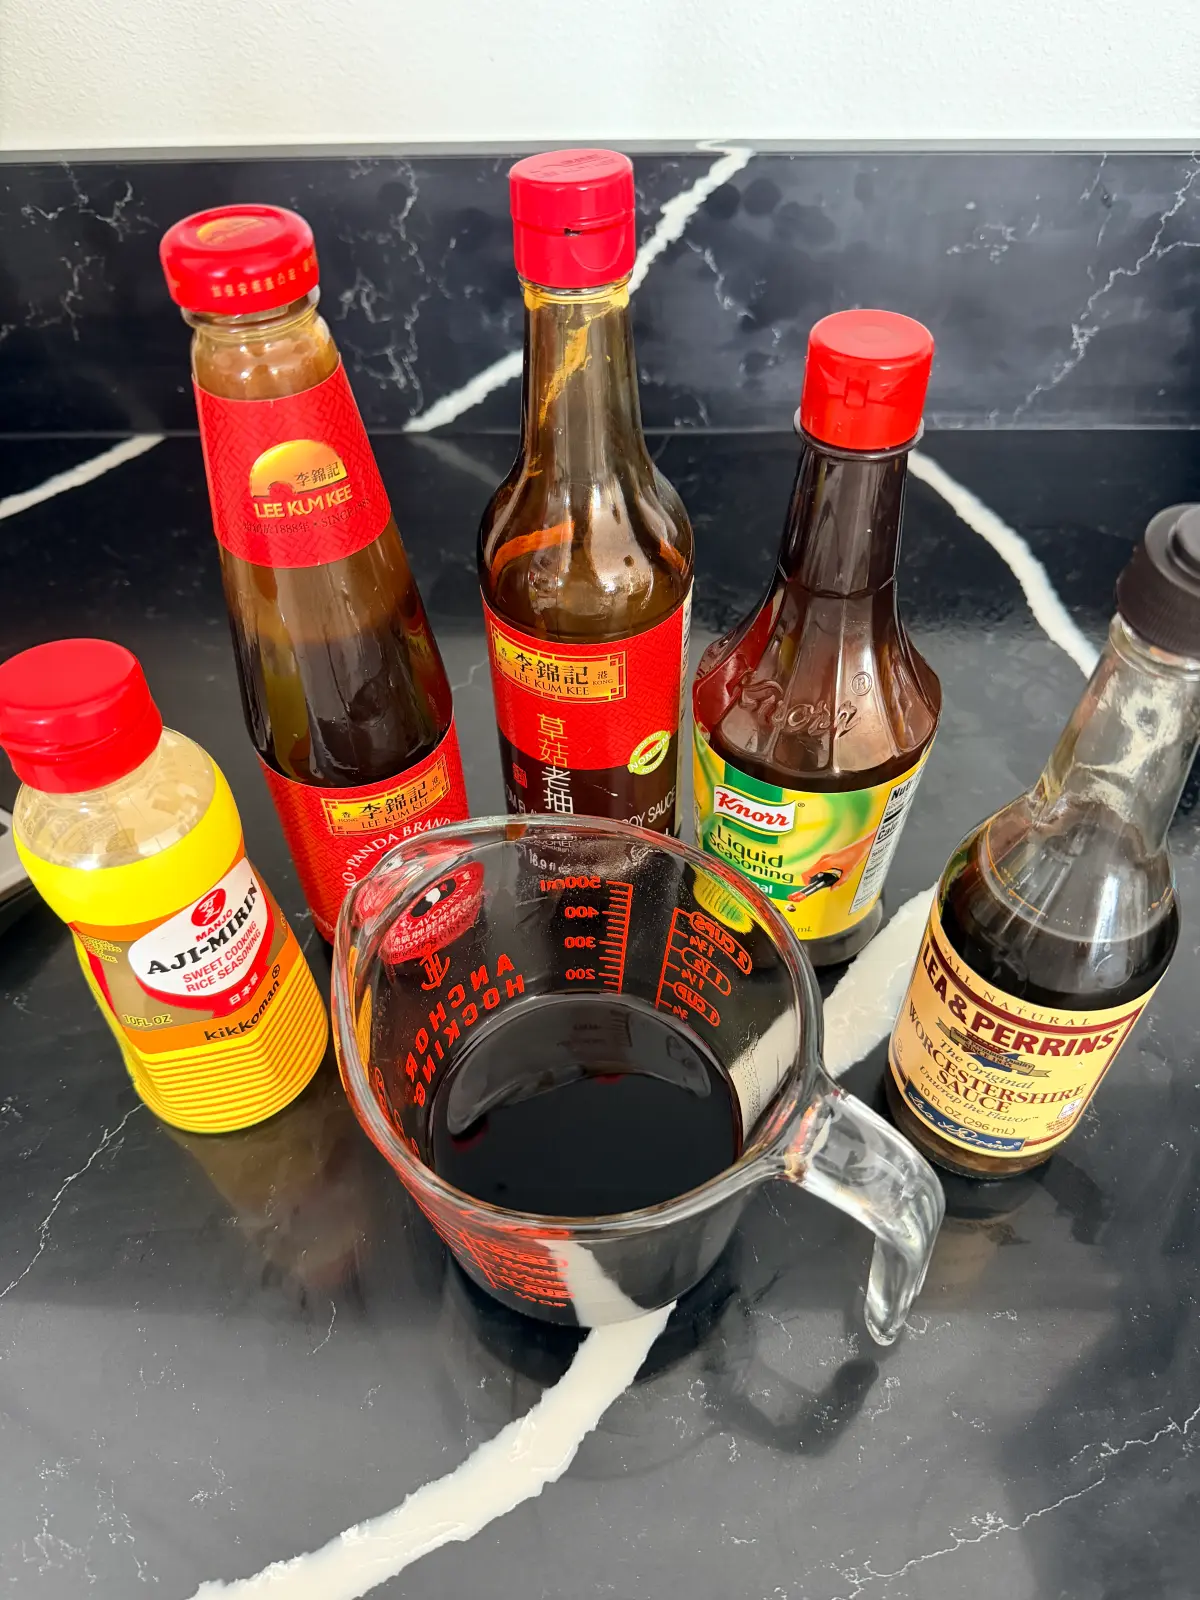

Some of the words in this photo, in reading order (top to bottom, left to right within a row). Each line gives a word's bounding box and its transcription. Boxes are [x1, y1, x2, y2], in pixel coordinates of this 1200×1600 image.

[294, 461, 341, 487] 李錦記
[253, 501, 286, 519] LEE
[287, 495, 325, 517] KUM
[325, 484, 354, 509] KEE
[512, 651, 589, 686] 李錦記
[513, 669, 532, 686] LEE
[533, 679, 563, 694] KUM
[566, 686, 590, 696] KEE
[536, 713, 574, 815] 草菇老抽
[357, 780, 429, 820] 李錦記
[361, 817, 381, 830] LEE
[384, 809, 411, 824] KUM
[412, 796, 430, 813] KEE
[647, 784, 677, 824] SAUCE
[715, 791, 790, 827] Knorr
[348, 832, 401, 868] PANDA
[709, 831, 795, 884] Seasoning
[717, 824, 784, 869] Liquid
[147, 878, 259, 975] AJI-MIRIN
[194, 908, 234, 943] MANJO
[182, 955, 223, 984] SWEET
[224, 920, 258, 962] COOKING
[185, 976, 217, 993] RICE
[217, 929, 262, 980] SEASONING
[203, 979, 281, 1041] kikkoman
[922, 942, 948, 1005] LEA
[947, 993, 968, 1026] &
[969, 1009, 1120, 1057] PERRINS
[946, 954, 972, 987] ALL
[982, 990, 1092, 1027] NATURAL
[909, 998, 1085, 1105] WORCESTERSHIRE
[940, 1038, 964, 1063] The
[966, 1061, 1036, 1090] Original
[963, 1042, 991, 1060] SINCE
[1005, 1056, 1034, 1070] Quality
[919, 1064, 962, 1107] Unwrap
[963, 1102, 985, 1116] the
[920, 1082, 931, 1097] 10
[931, 1094, 943, 1110] FL
[944, 1104, 961, 1120] OZ
[963, 1115, 990, 1132] (296
[991, 1126, 1016, 1136] mL)
[936, 1069, 1012, 1115] SAUCE
